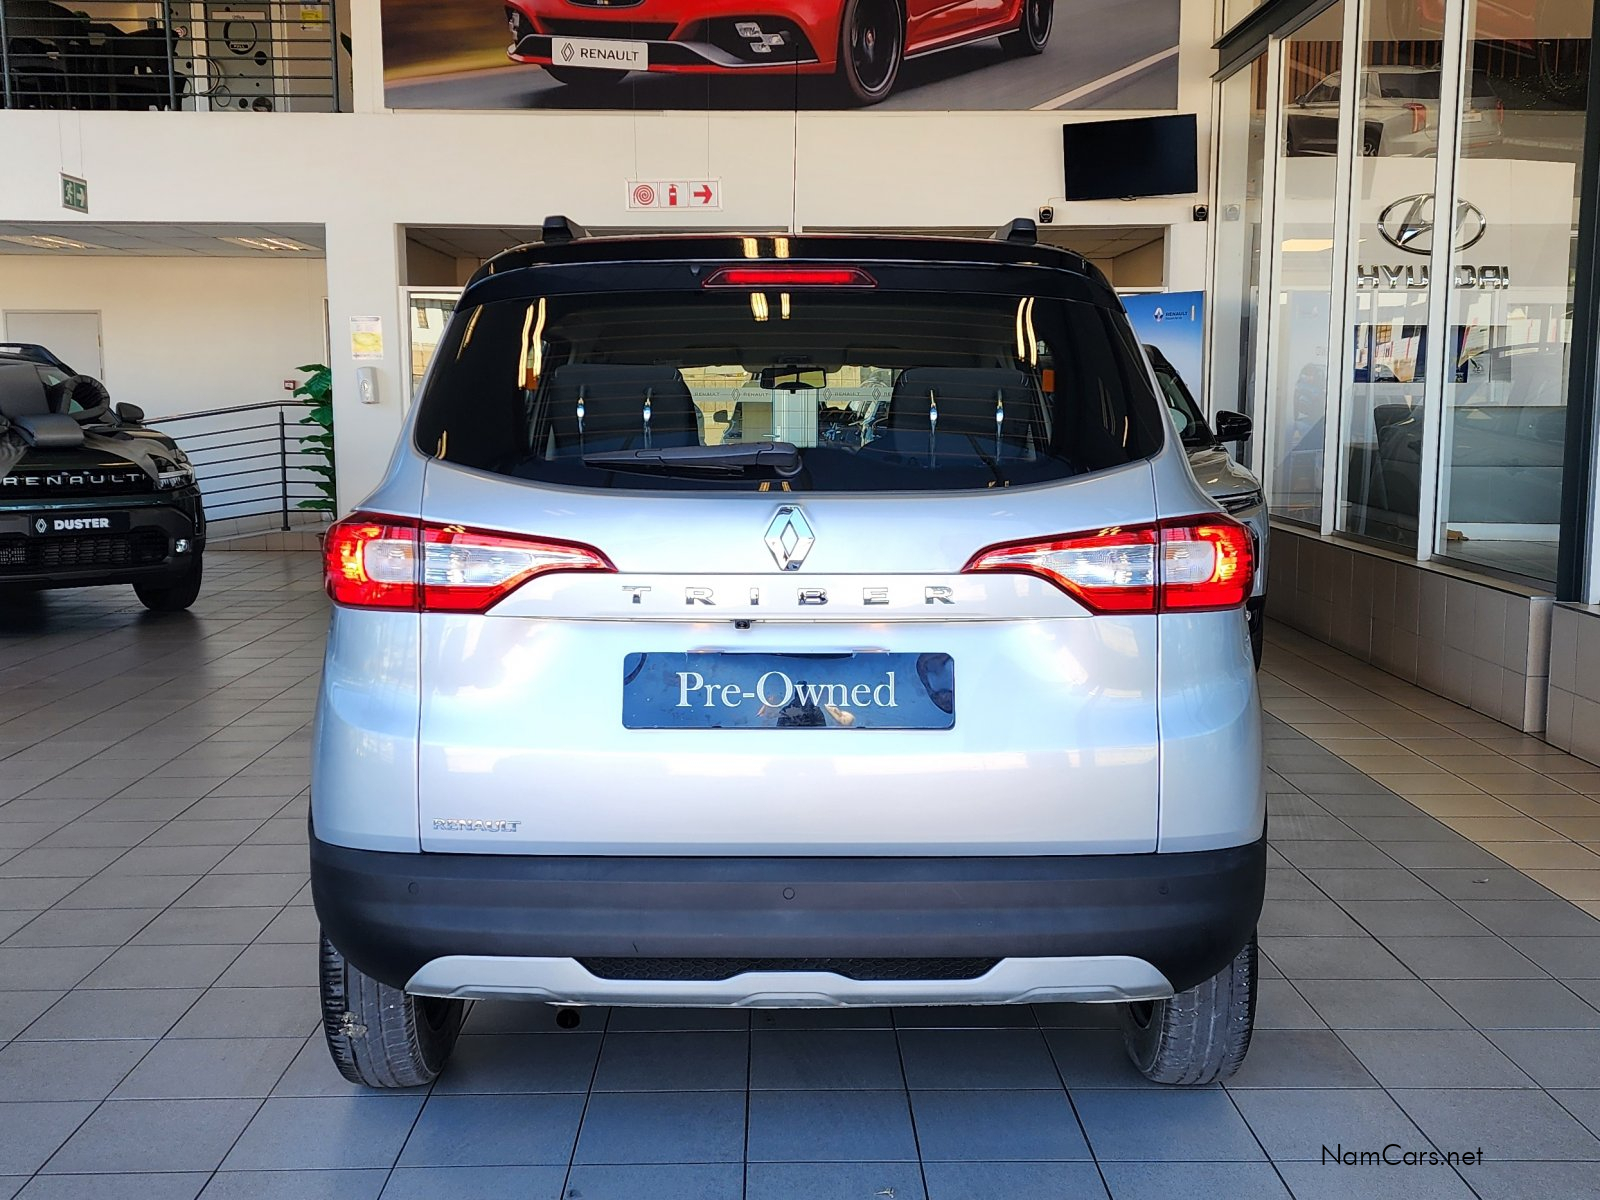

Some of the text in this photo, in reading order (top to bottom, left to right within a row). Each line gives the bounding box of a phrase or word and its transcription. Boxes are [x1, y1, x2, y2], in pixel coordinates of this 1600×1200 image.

[580, 47, 639, 62] RENAULT
[1357, 264, 1508, 289] HYUDAI
[2, 473, 140, 487] RENAULT
[53, 517, 110, 531] DUSTER
[622, 585, 955, 606] TRIBER
[675, 671, 898, 708] Pre-Owned
[432, 817, 522, 833] RENAULT
